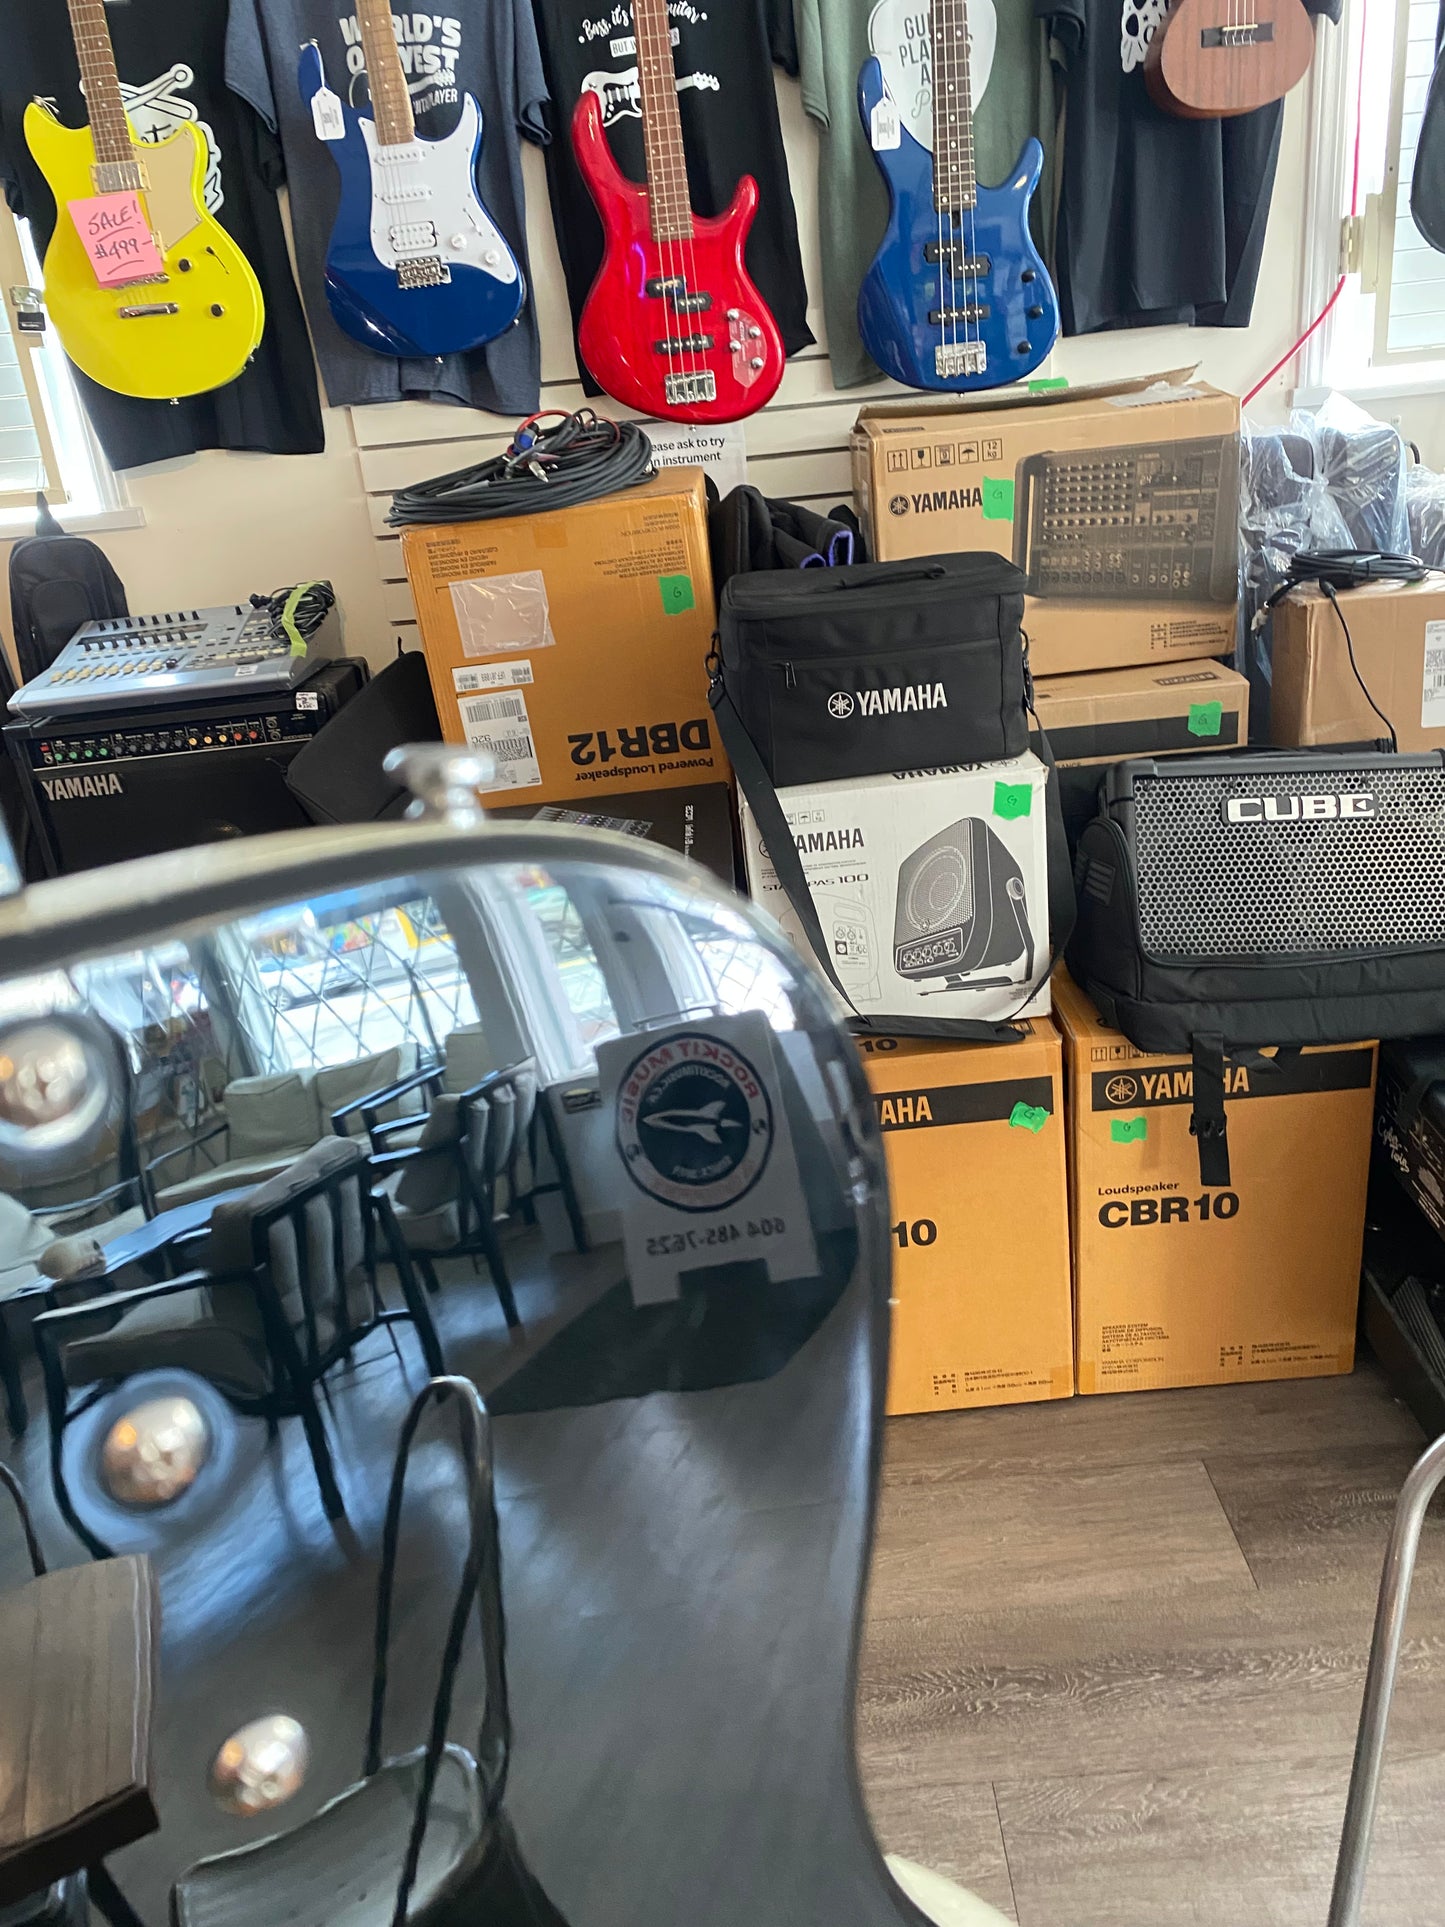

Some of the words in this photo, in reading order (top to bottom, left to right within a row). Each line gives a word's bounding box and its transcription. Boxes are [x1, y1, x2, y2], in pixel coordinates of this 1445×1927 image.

[339, 13, 461, 48] WRLD'S
[346, 44, 460, 75] OYEST
[612, 40, 628, 55] BUT
[88, 200, 142, 236] SALE!
[651, 443, 675, 452] ease
[677, 439, 694, 450] ask
[696, 439, 708, 447] to
[710, 437, 725, 448] try
[662, 452, 721, 466] instrument
[911, 487, 983, 513] YAMAHA
[856, 682, 948, 716] YAMAHA
[567, 719, 712, 766] DBR12
[575, 764, 656, 782] Loudspeaker
[659, 757, 714, 774] Powered
[41, 773, 123, 801] YAMAHA
[1228, 793, 1375, 822] CUBE
[795, 828, 865, 853] AMAHA
[1141, 1066, 1250, 1100] YAMHA
[880, 1095, 933, 1125] AHA
[1098, 1181, 1180, 1196] Loudspeaker
